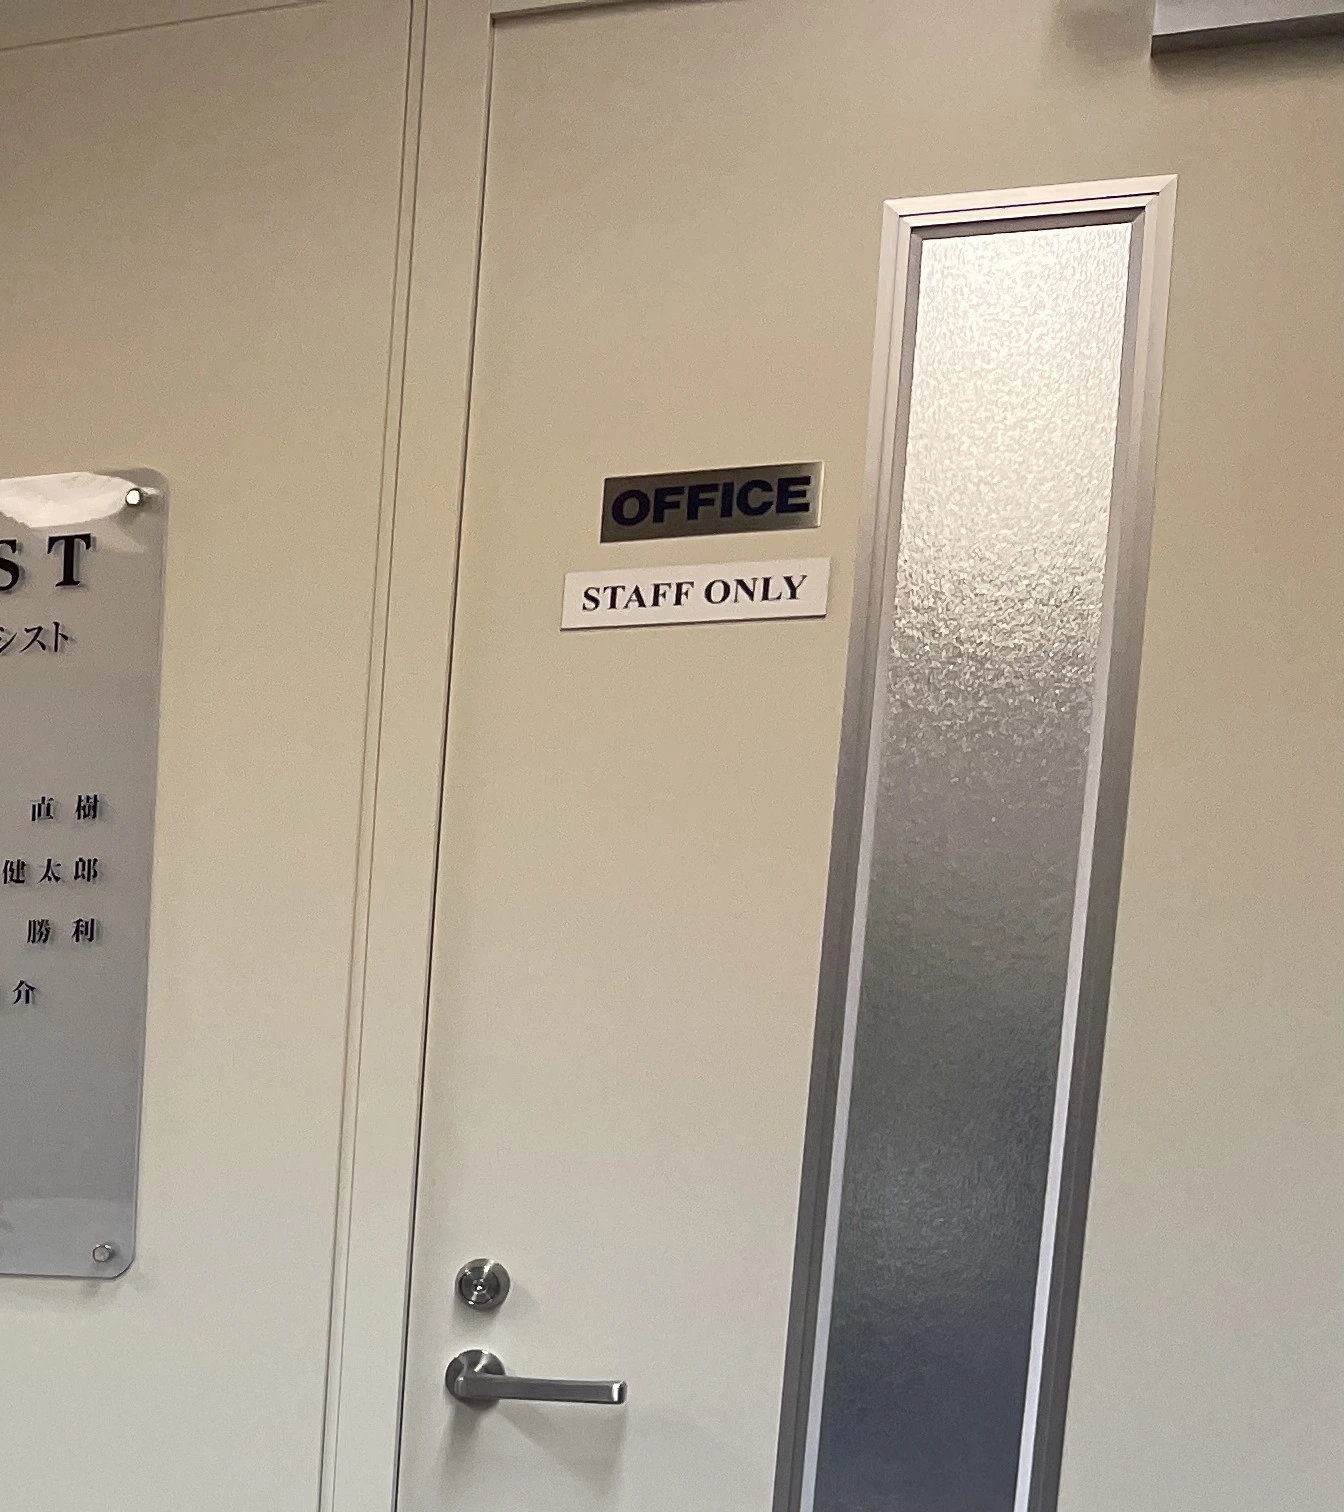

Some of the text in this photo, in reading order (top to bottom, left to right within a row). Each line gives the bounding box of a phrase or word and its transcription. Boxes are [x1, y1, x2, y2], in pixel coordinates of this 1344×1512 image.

[612, 475, 811, 526] OFFICE
[582, 574, 808, 611] STAFF ONLY
[31, 794, 100, 822] 直樹
[2, 857, 99, 885] 健太郎
[26, 918, 96, 944] 勝利
